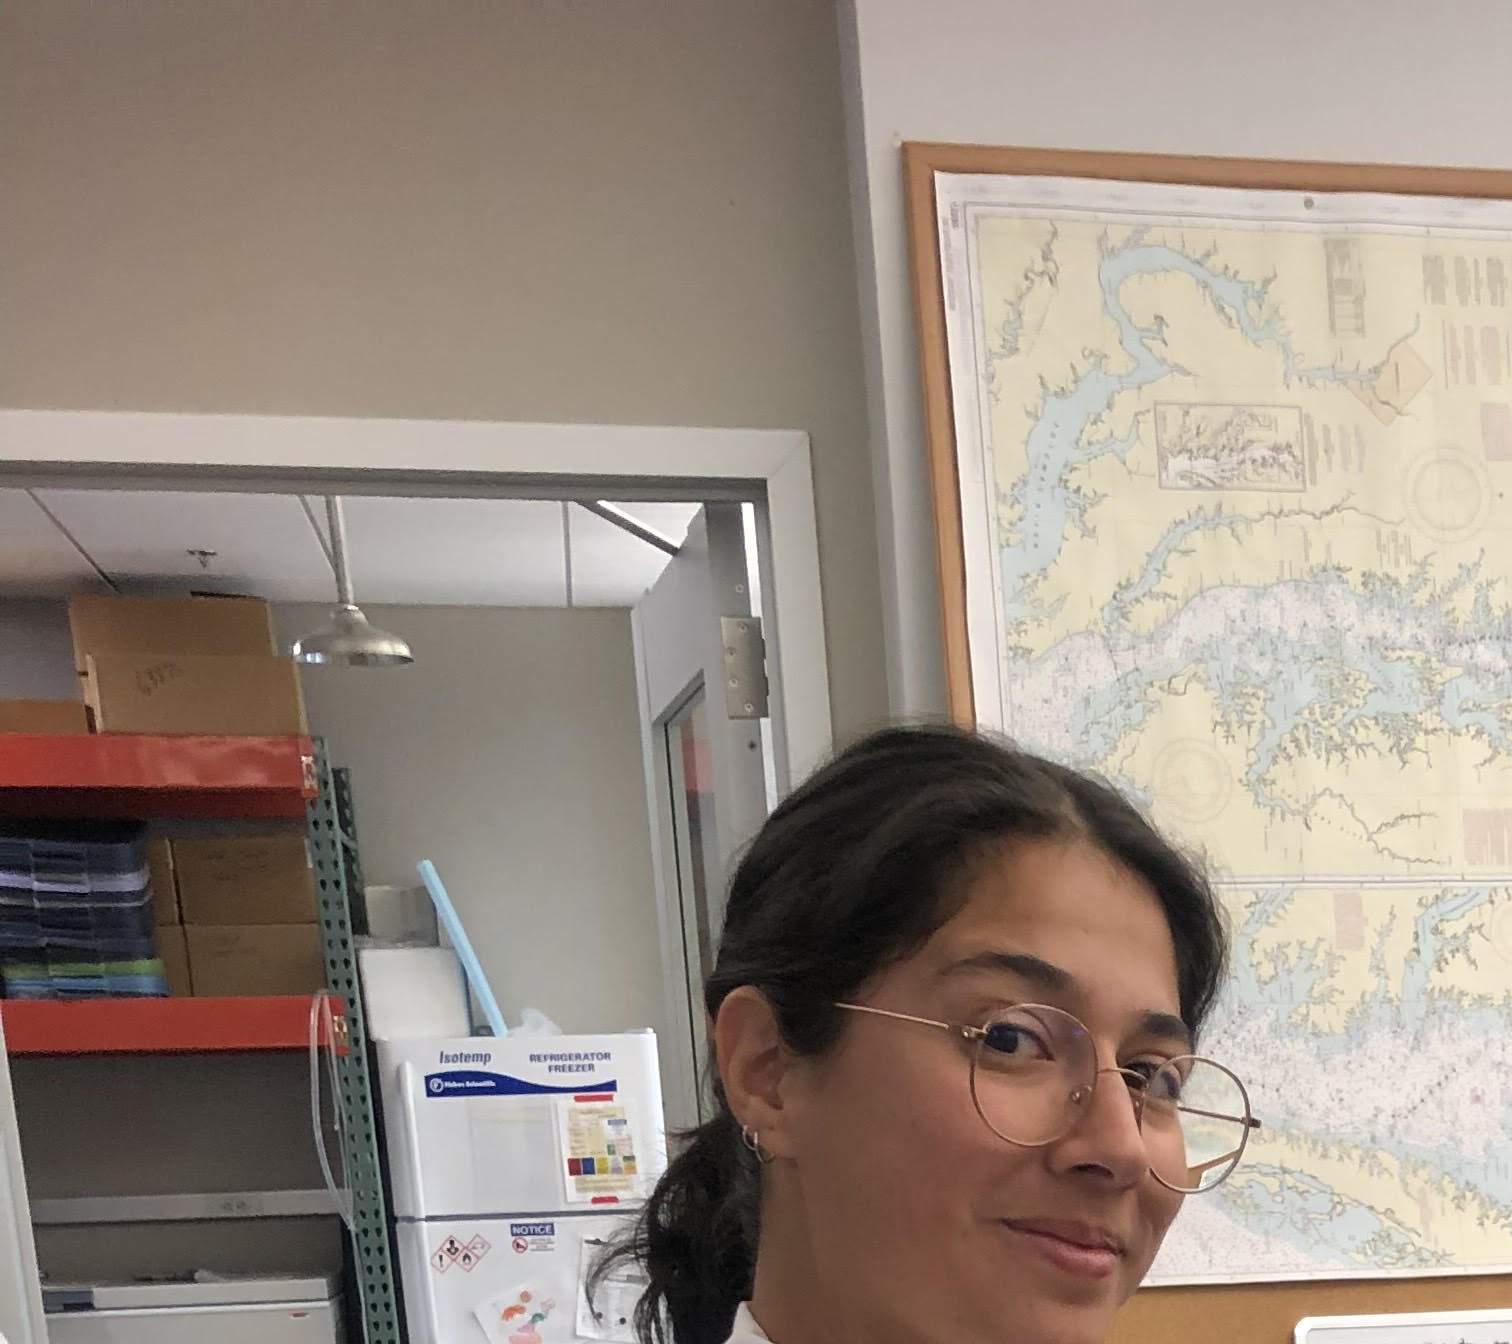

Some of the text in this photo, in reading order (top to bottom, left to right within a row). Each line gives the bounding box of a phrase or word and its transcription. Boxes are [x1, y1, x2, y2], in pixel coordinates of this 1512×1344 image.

[439, 1050, 492, 1066] Isotemp
[529, 1051, 612, 1063] REFRIGERATOR
[548, 1063, 596, 1073] FREEZER
[512, 1224, 553, 1236] NOTICE
